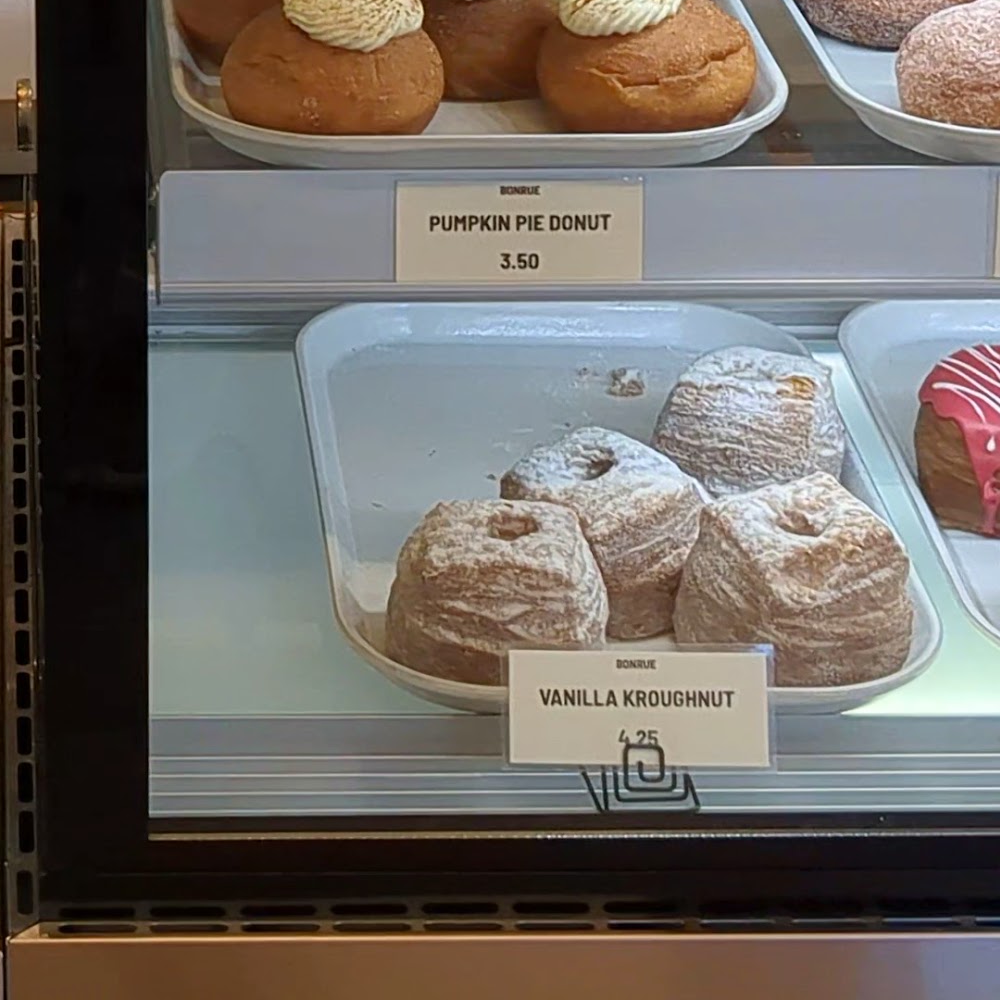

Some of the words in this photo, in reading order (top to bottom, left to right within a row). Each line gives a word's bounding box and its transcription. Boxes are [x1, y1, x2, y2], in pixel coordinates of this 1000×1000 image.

[500, 186, 541, 196] BONRUE
[429, 215, 511, 232] PUMPKIN
[515, 215, 545, 231] PIE
[549, 213, 612, 231] DONUT
[500, 253, 540, 270] 3.50
[616, 659, 656, 670] BONRUE
[539, 688, 618, 707] VANILLA
[623, 689, 735, 708] KROUGHNUT
[618, 729, 659, 746] 425
